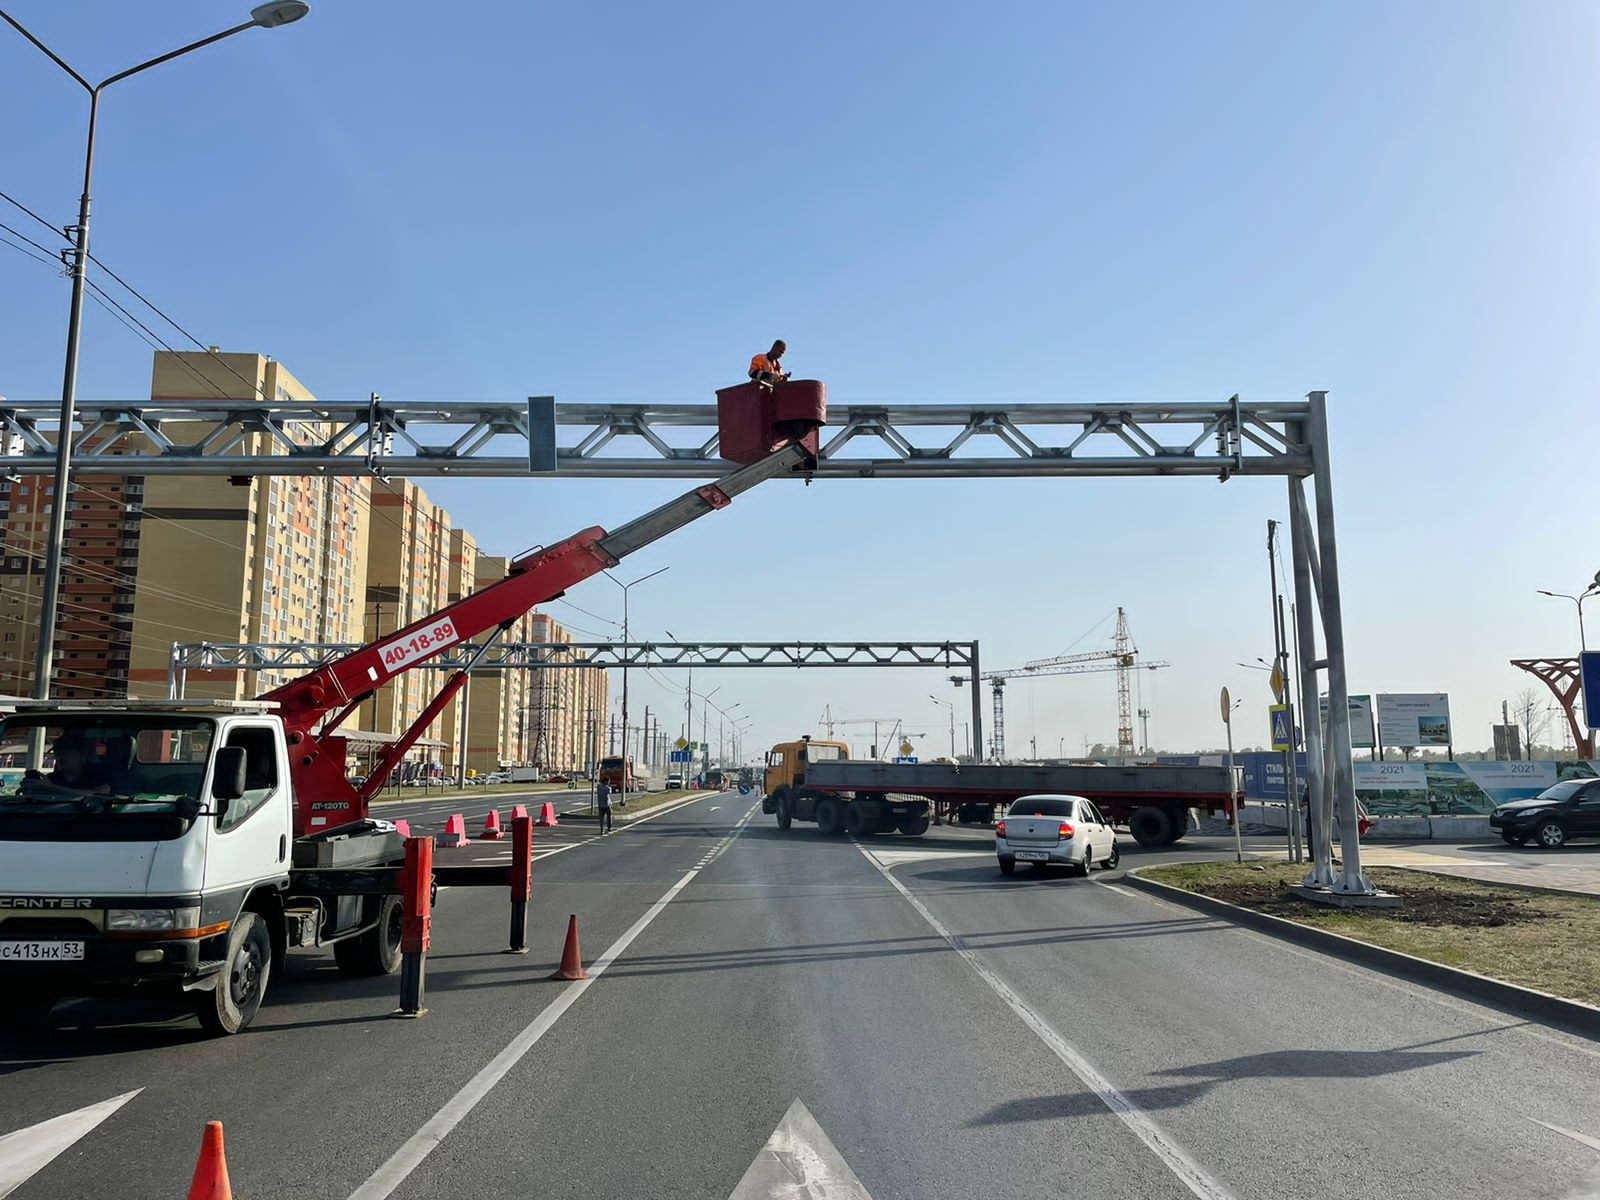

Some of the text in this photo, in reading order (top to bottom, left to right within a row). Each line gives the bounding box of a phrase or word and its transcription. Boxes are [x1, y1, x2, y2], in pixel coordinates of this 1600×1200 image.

[385, 623, 453, 665] 40-18-89
[1379, 765, 1404, 774] 2021
[1511, 764, 1535, 773] 2021
[0, 898, 92, 908] CANTER
